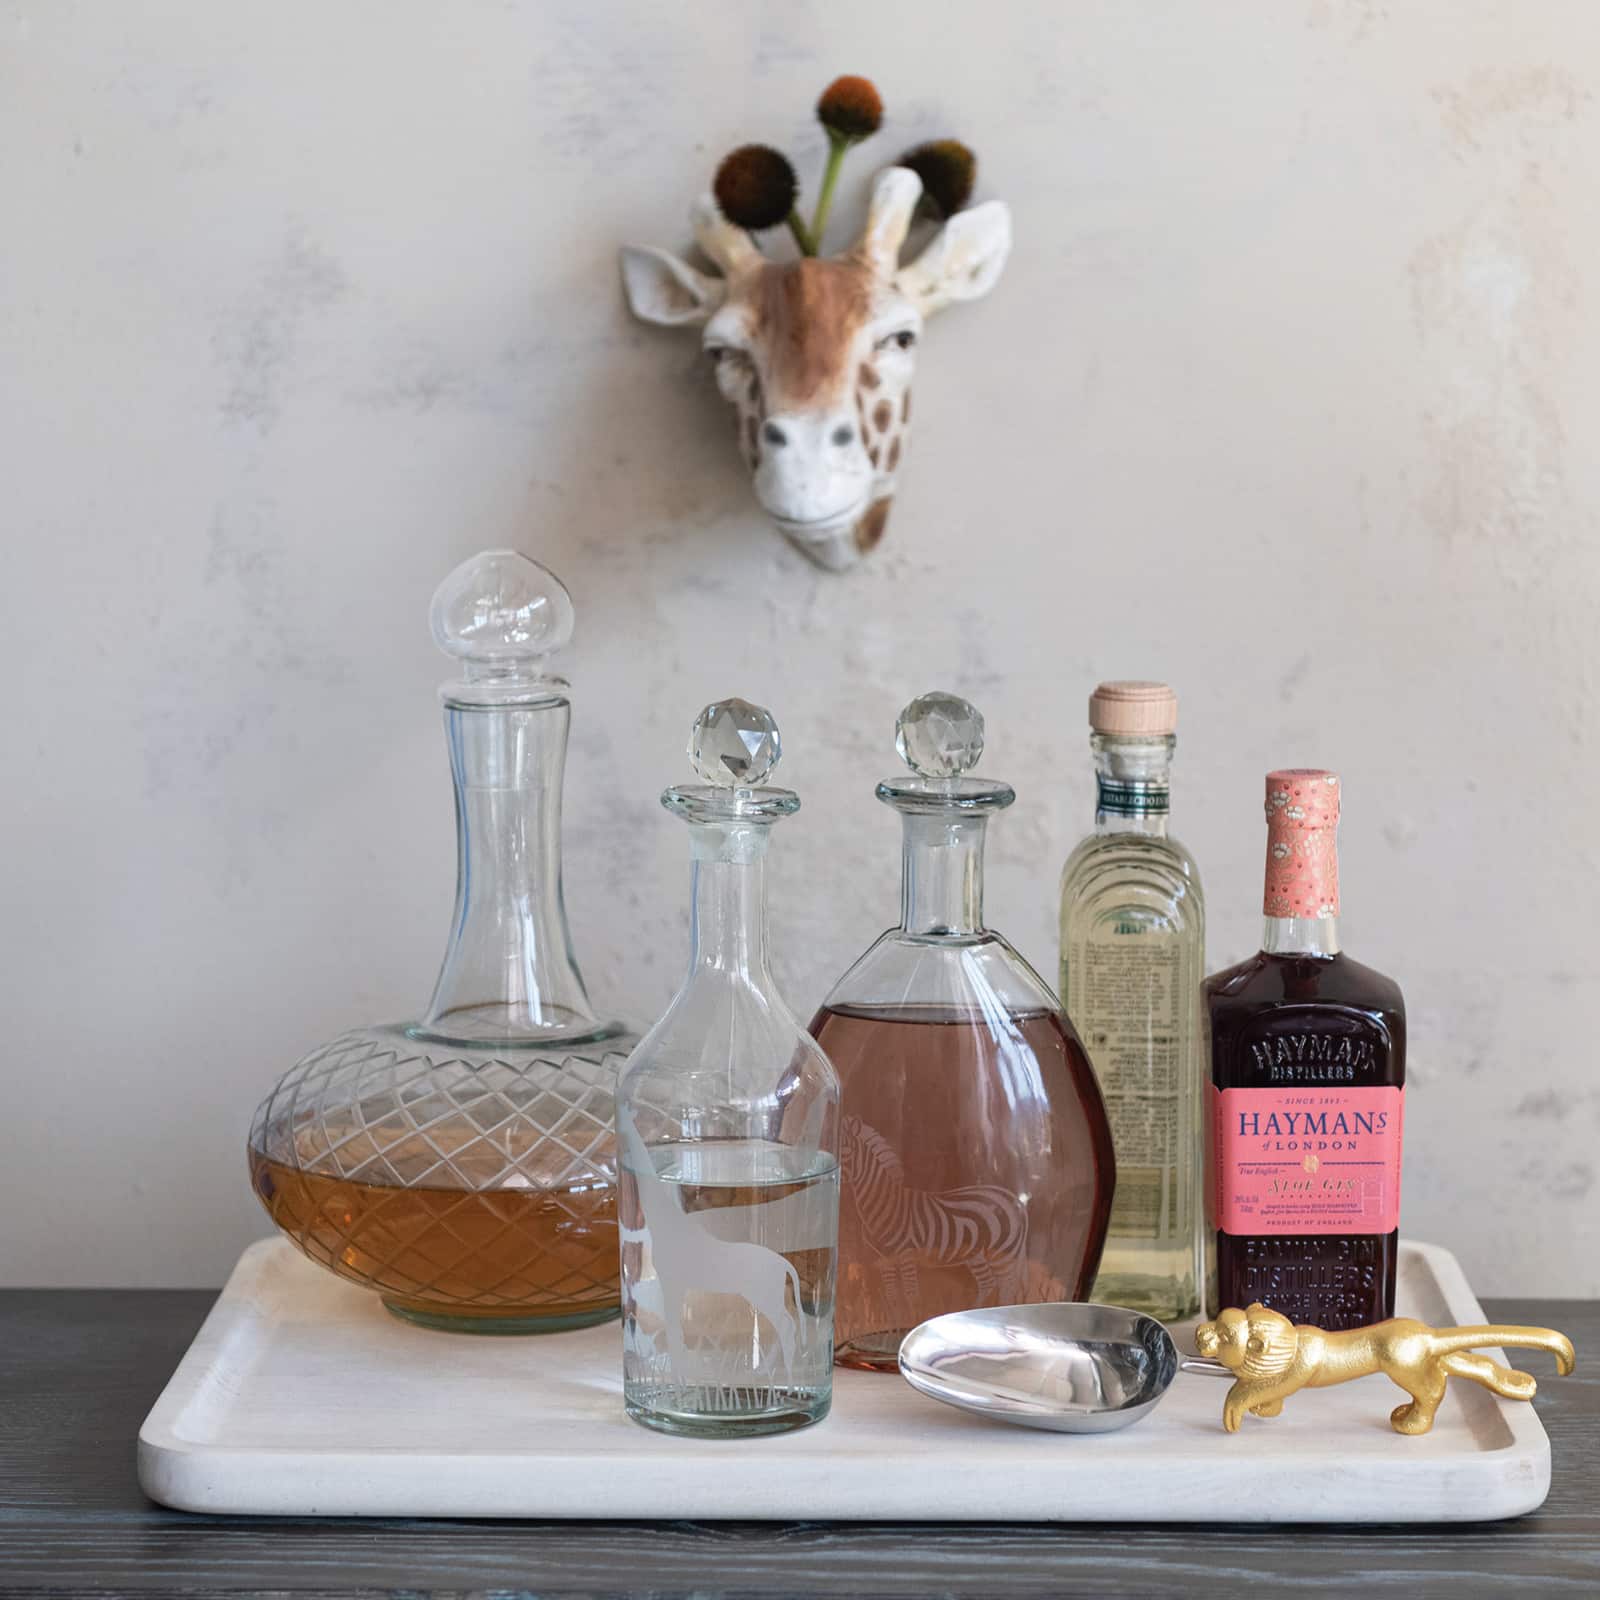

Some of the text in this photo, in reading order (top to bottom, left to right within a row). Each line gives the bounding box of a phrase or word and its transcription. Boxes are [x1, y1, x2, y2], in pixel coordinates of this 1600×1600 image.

[1271, 1066, 1354, 1080] DISTILLERS
[1285, 1097, 1314, 1105] SINCE
[1276, 1141, 1357, 1150] LONDON
[1247, 1265, 1374, 1288] DISTILLERS
